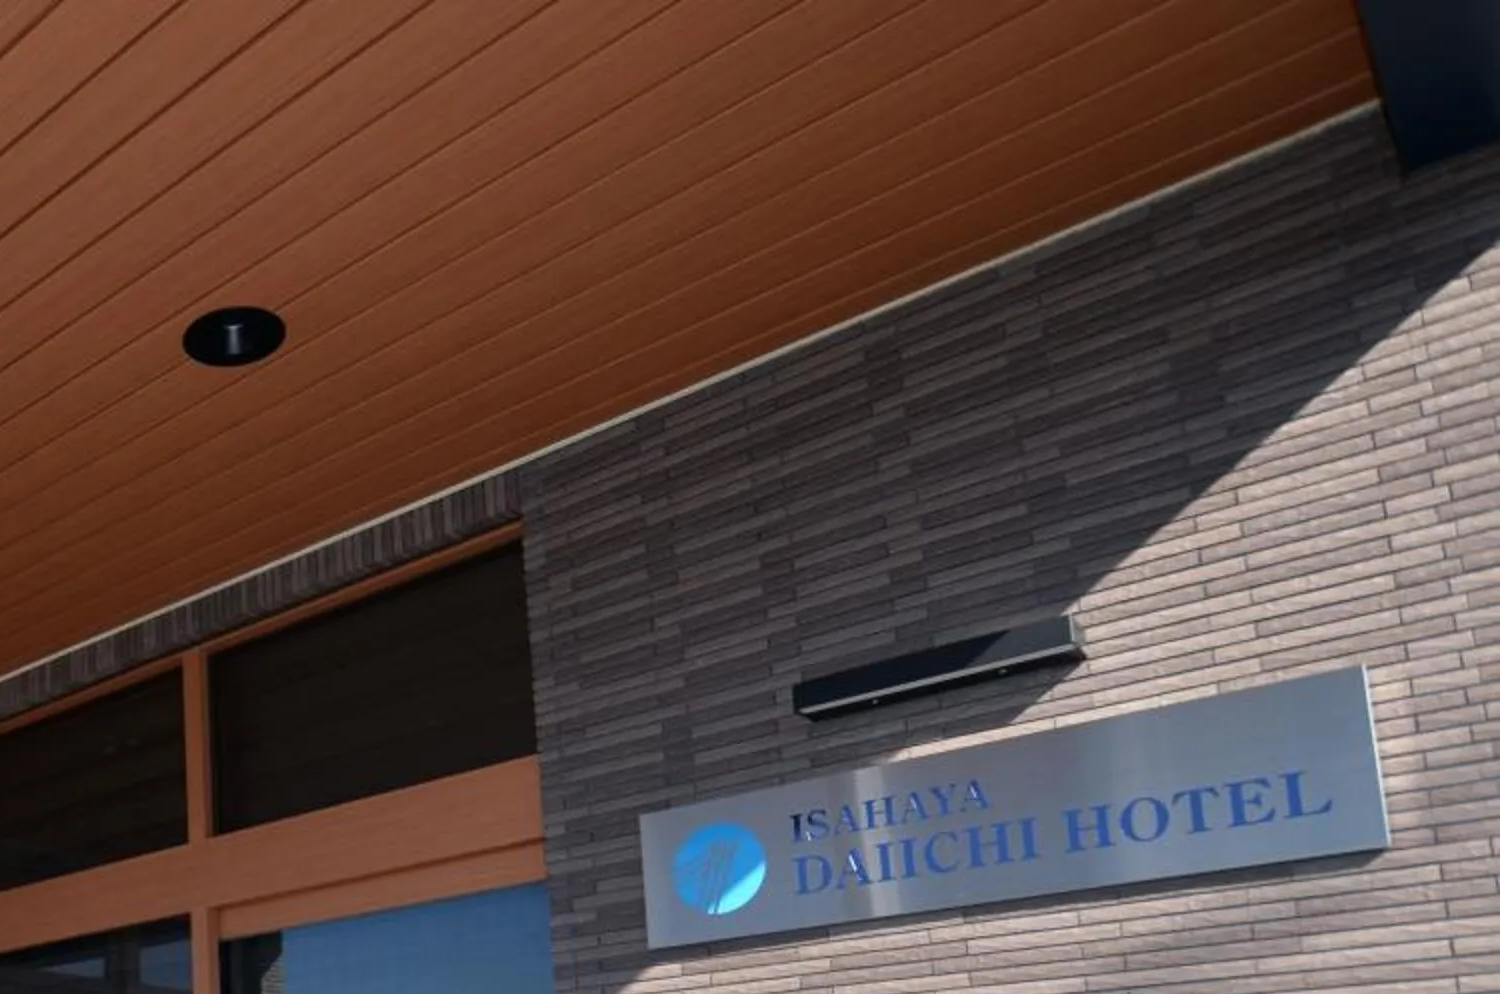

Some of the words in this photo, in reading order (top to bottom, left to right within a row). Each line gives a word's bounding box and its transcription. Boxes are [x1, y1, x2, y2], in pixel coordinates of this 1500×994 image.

[789, 779, 990, 844] ISAHAYA
[794, 817, 1039, 896] DAIICHI
[1063, 770, 1334, 855] HOTEL
